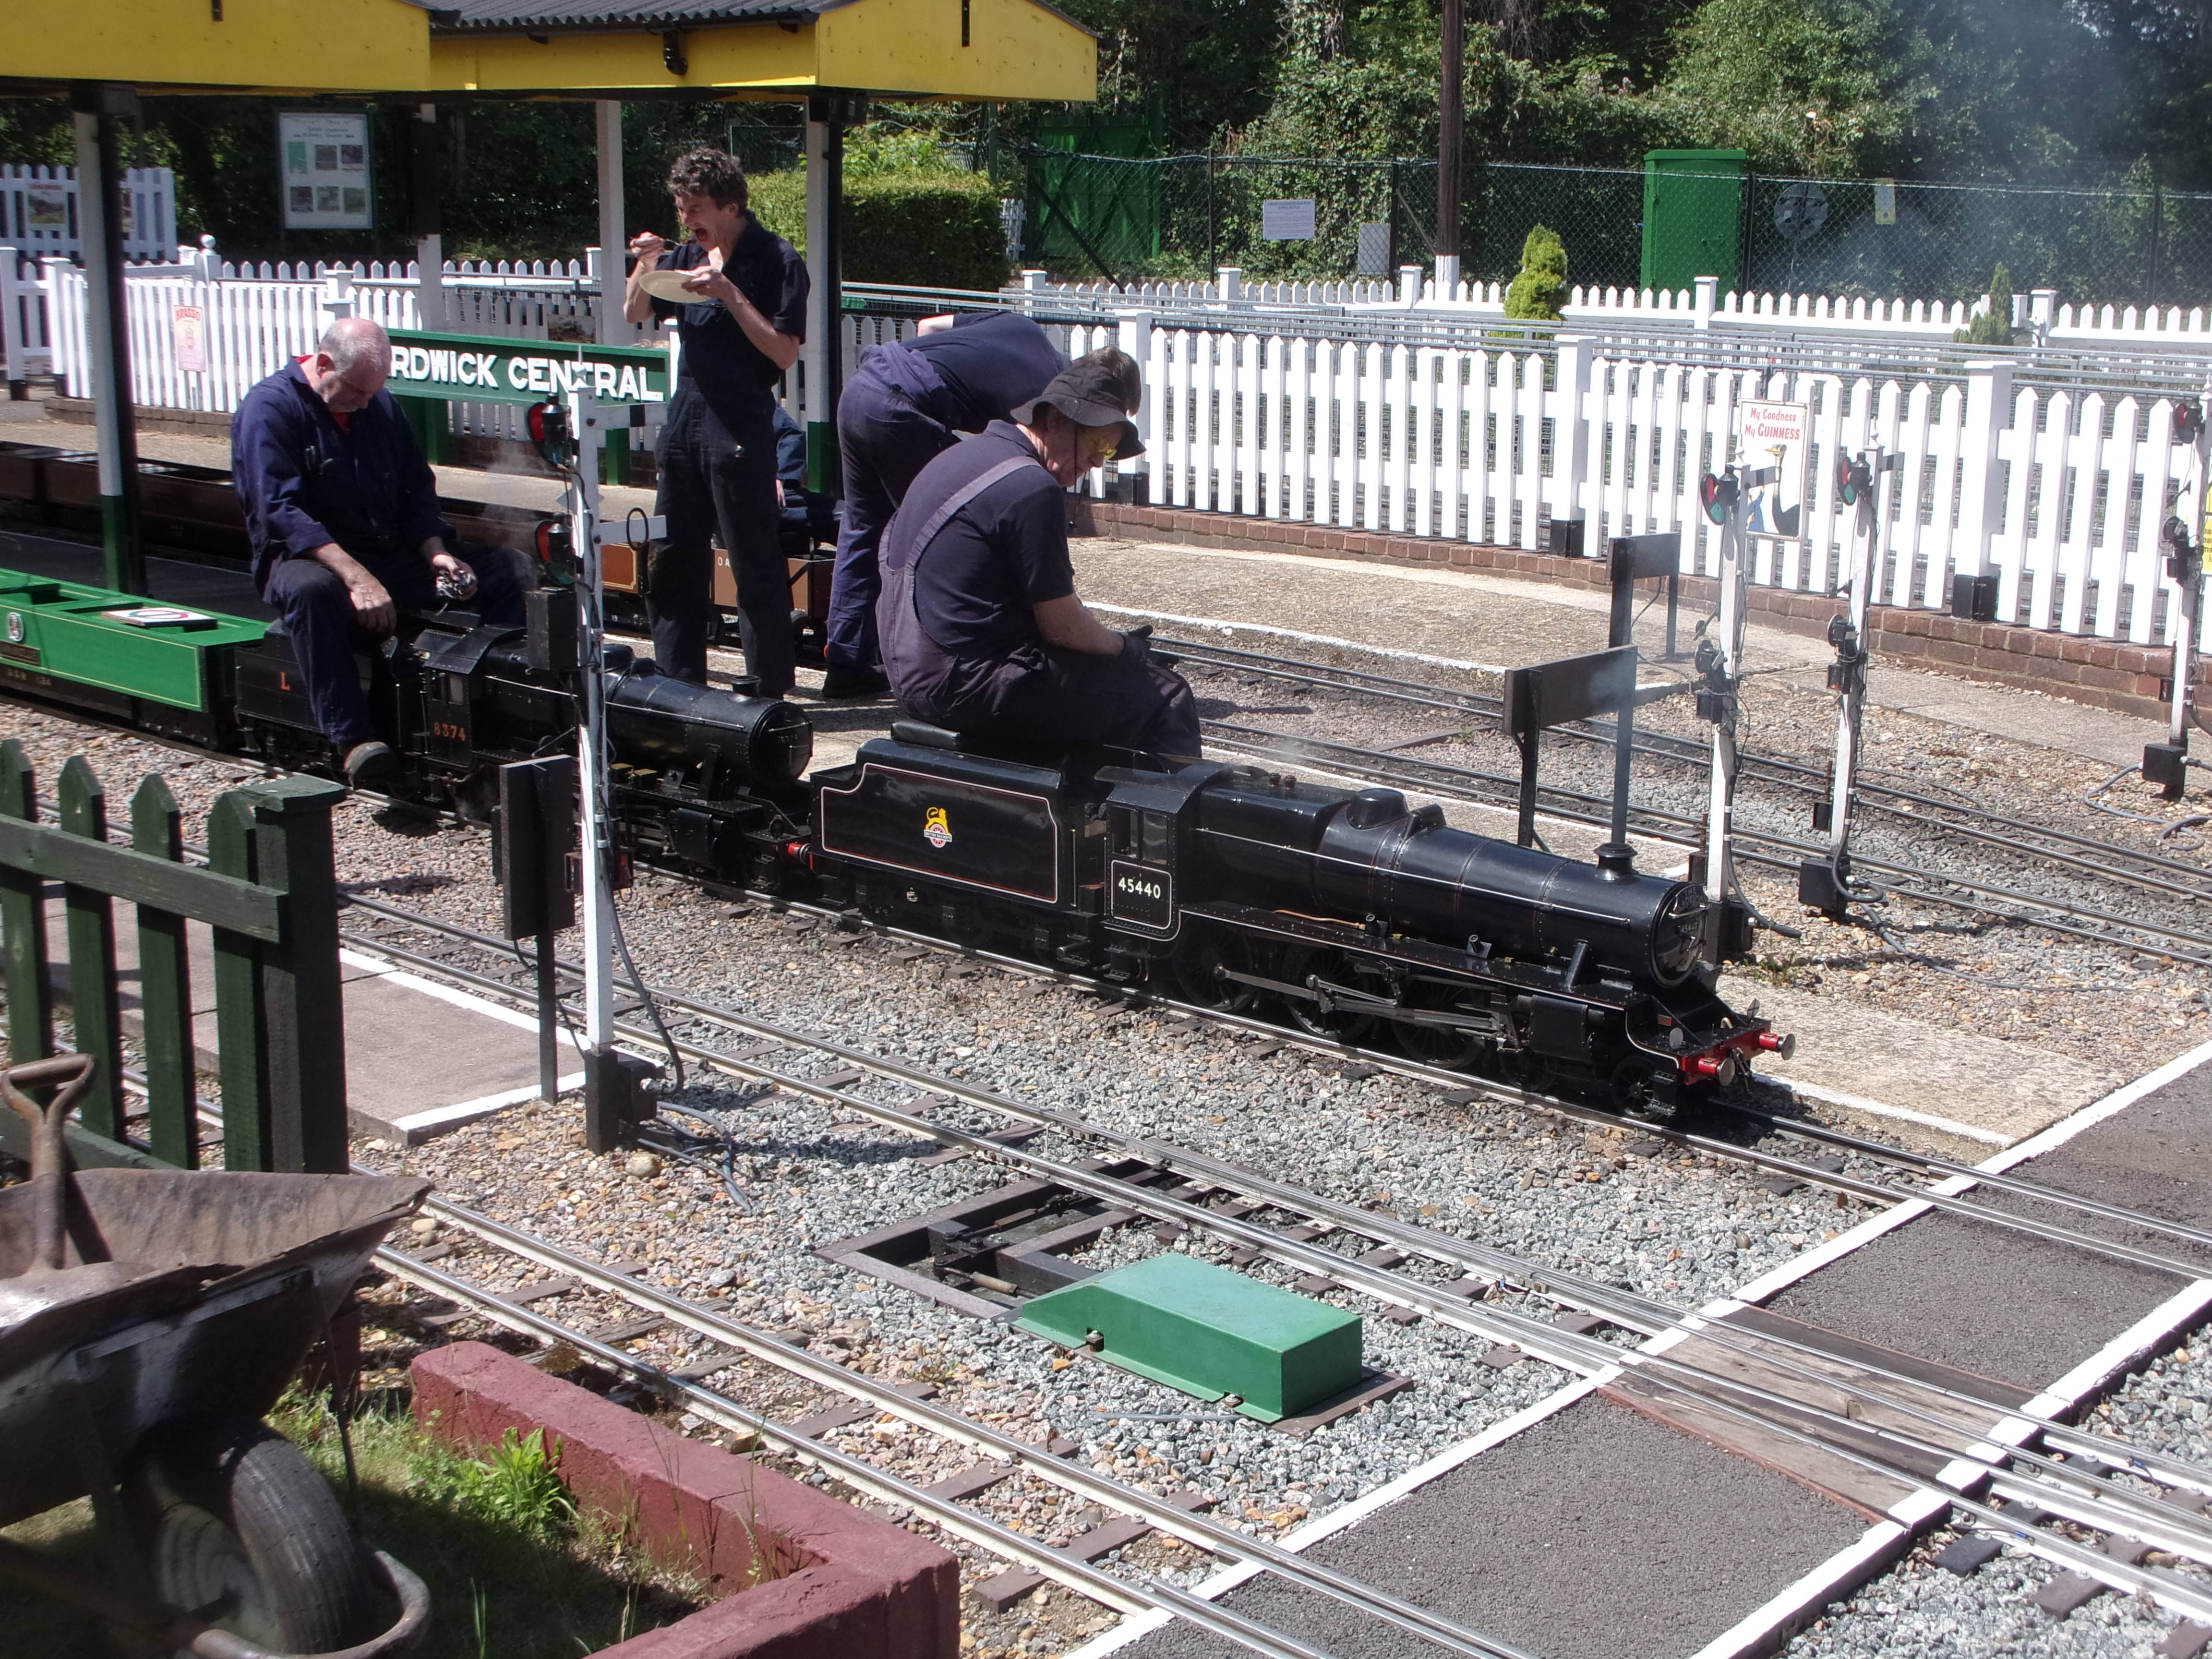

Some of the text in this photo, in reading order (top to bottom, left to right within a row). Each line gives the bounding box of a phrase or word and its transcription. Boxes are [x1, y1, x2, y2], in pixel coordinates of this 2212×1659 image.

[388, 345, 664, 401] RDWICK CENTRAL
[1750, 408, 1797, 421] My Goodness
[1744, 423, 1800, 440] My GUINNESS
[433, 722, 466, 741] 8374
[1118, 877, 1161, 899] 45440
